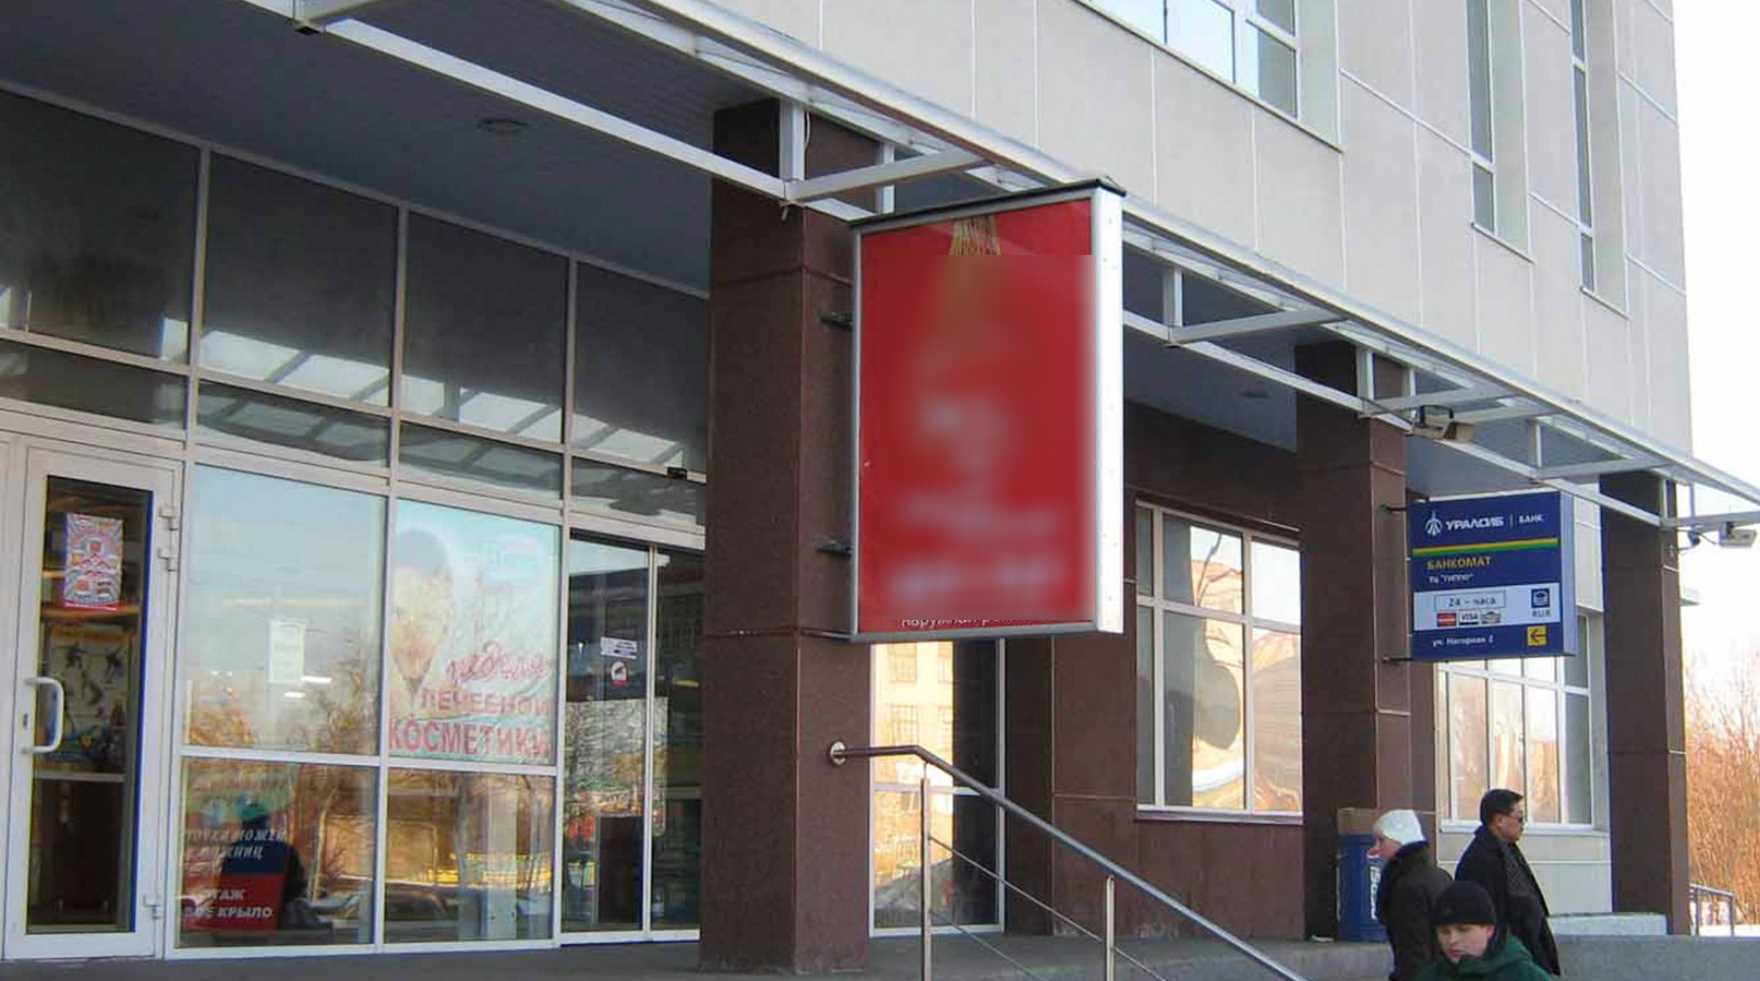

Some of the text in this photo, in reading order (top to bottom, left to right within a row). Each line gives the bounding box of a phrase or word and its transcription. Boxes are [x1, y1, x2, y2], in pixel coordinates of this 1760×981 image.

[1446, 515, 1543, 530] УРАЛСИБ БАНК
[1427, 556, 1491, 570] БАНКОМАТ
[1449, 598, 1461, 607] 24
[217, 906, 273, 918] КРЫЛО
